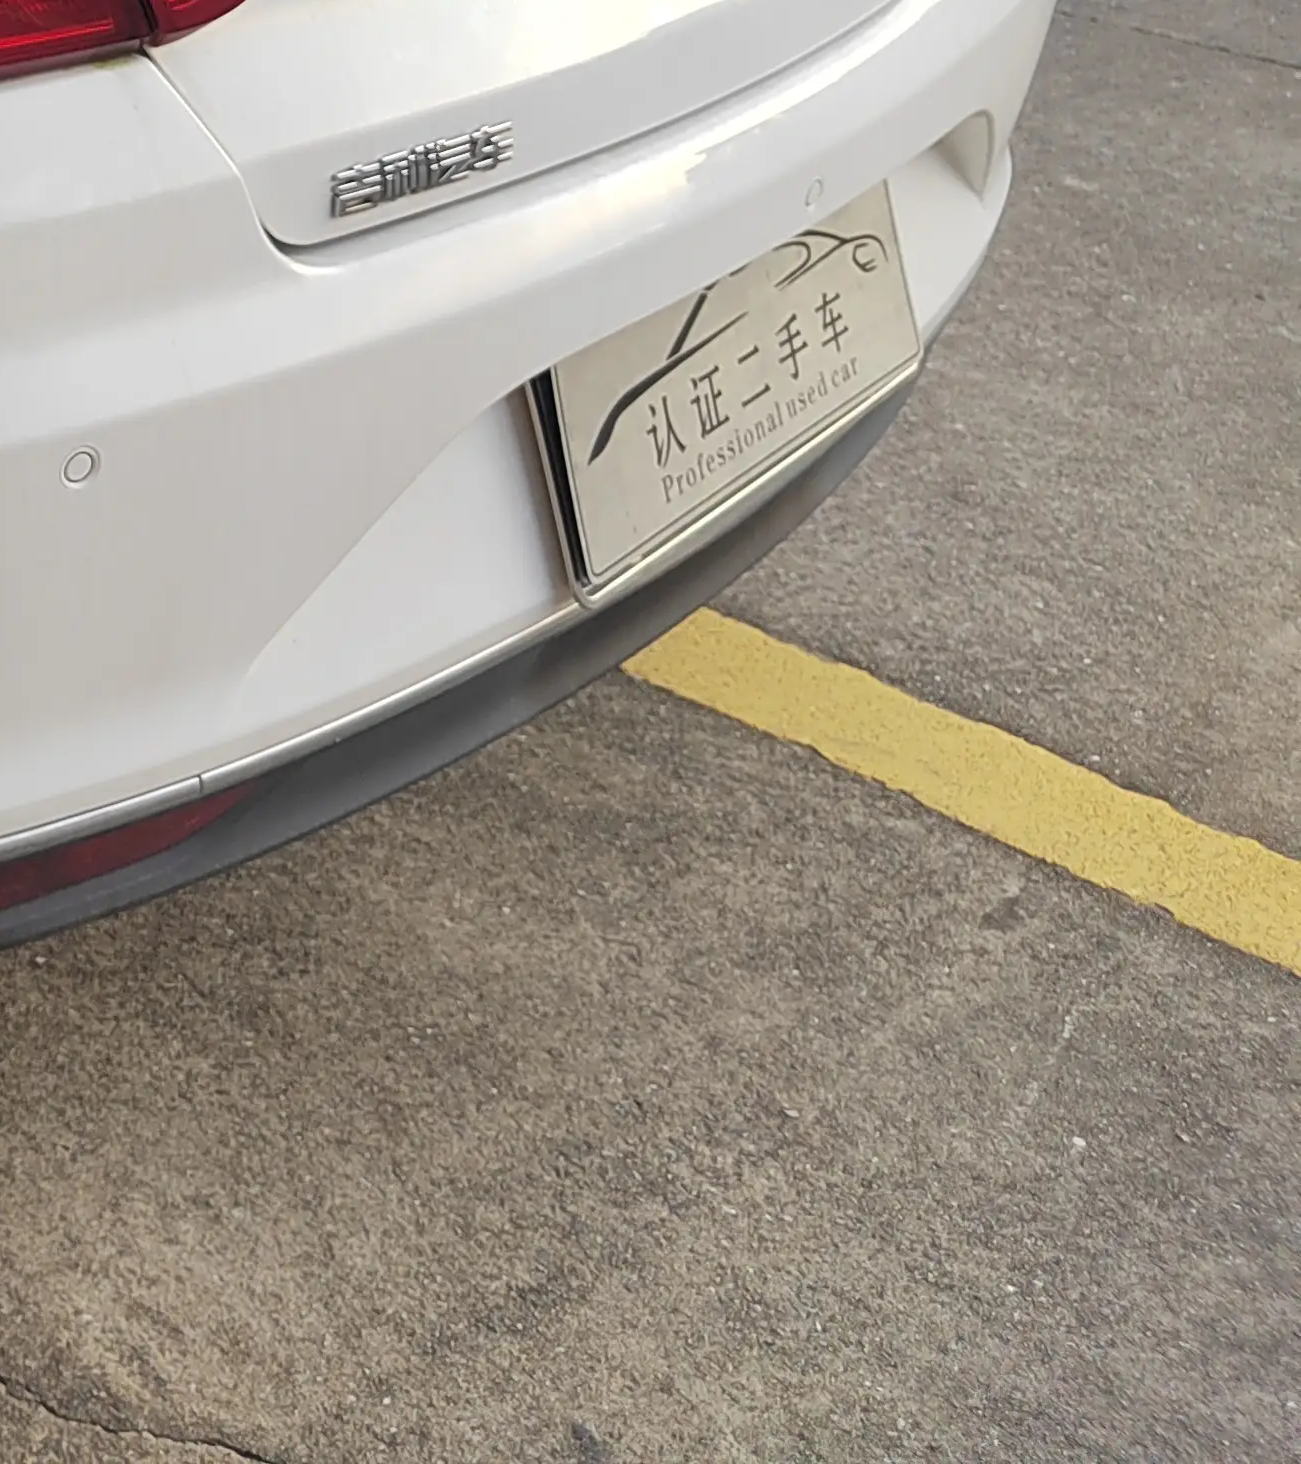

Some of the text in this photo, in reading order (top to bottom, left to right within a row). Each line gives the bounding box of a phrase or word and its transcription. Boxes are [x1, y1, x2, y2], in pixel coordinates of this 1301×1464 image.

[330, 121, 513, 218] 吉利汽车
[645, 292, 849, 469] 认证二手车
[661, 356, 859, 505] Professional used car
